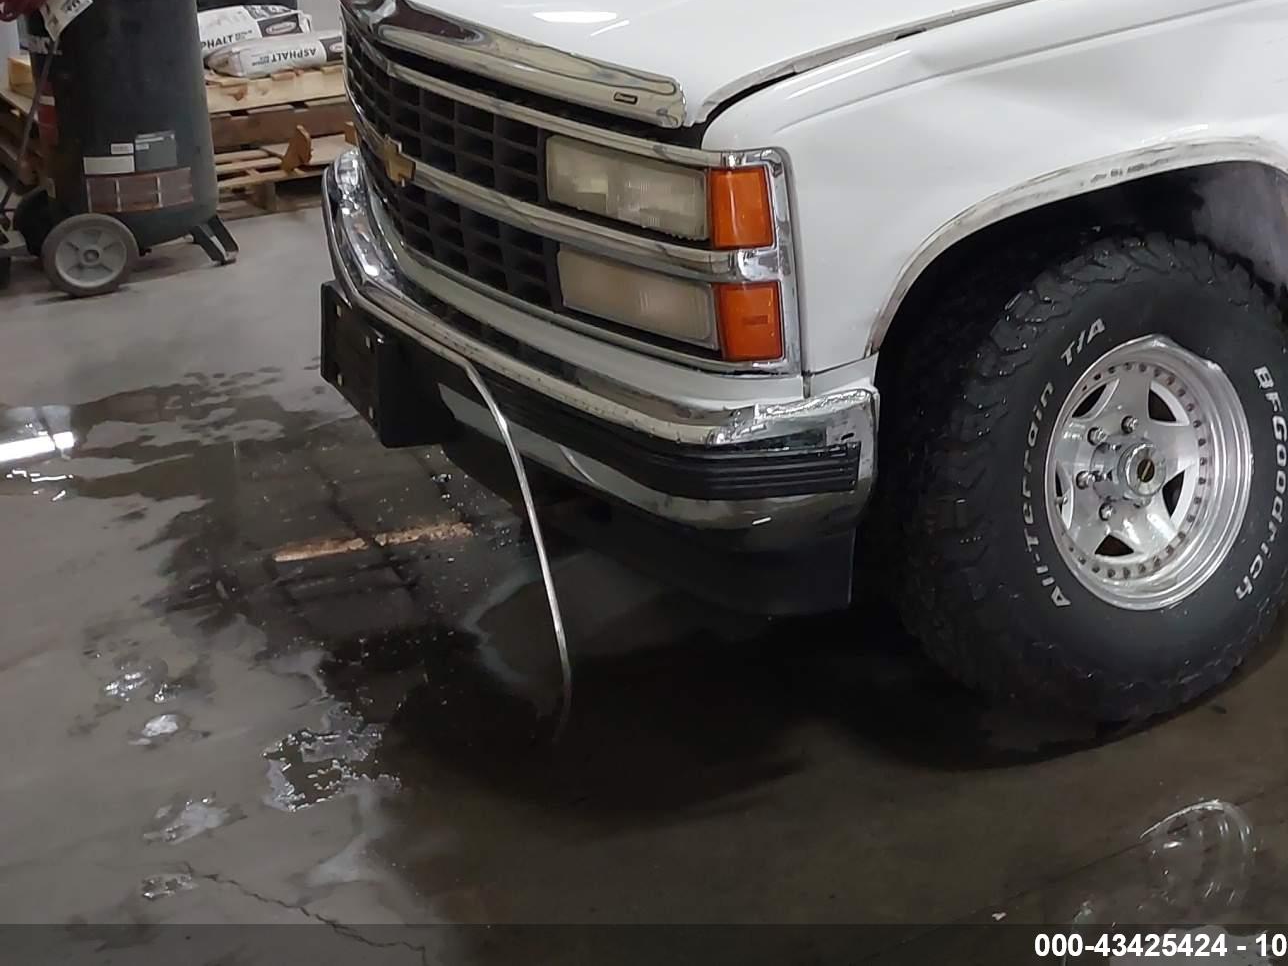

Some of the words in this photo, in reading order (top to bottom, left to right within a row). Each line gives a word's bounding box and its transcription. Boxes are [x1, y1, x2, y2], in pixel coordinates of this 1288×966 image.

[271, 48, 317, 65] ASPHALT
[1022, 382, 1071, 607] All-Terrain
[1060, 318, 1106, 366] T/A
[1235, 365, 1288, 600] BFGoodrich
